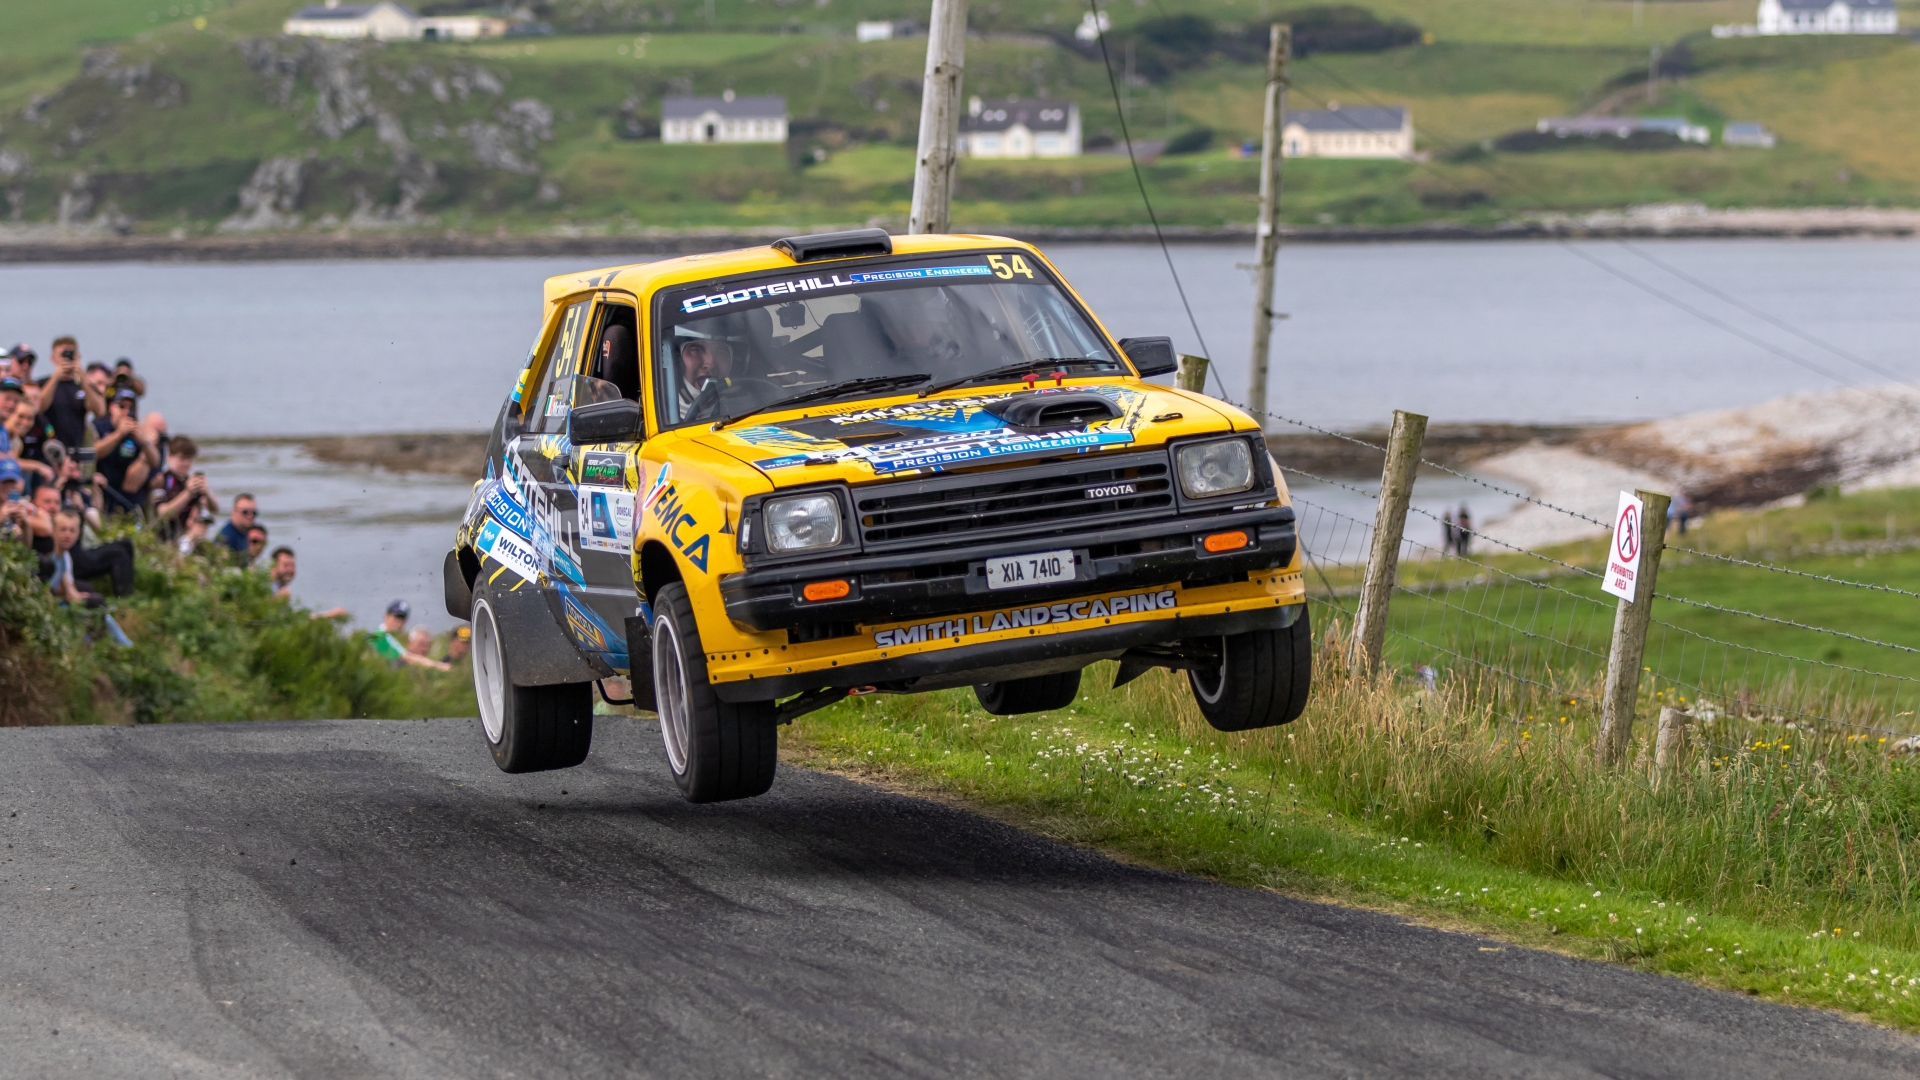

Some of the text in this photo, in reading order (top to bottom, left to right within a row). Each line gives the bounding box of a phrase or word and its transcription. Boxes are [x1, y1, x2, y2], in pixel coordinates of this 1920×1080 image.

[987, 254, 1034, 280] 54
[683, 275, 853, 313] COOTEHILL
[926, 266, 992, 276] ENGINEERIN
[555, 306, 582, 378] 54
[868, 431, 991, 450] TRITON
[893, 435, 1099, 469] PRECISION ENGINEERING
[1087, 484, 1134, 498] TOYOTA
[486, 483, 527, 534] PRECISION
[581, 497, 590, 531] 54
[653, 484, 710, 575] EMCA
[499, 536, 540, 571] WILTON
[1001, 557, 1061, 582] XIA 7410
[1610, 562, 1634, 582] PROHIBITED
[1614, 577, 1627, 591] AREA
[875, 590, 1176, 649] SMITH LANDSCAPING
